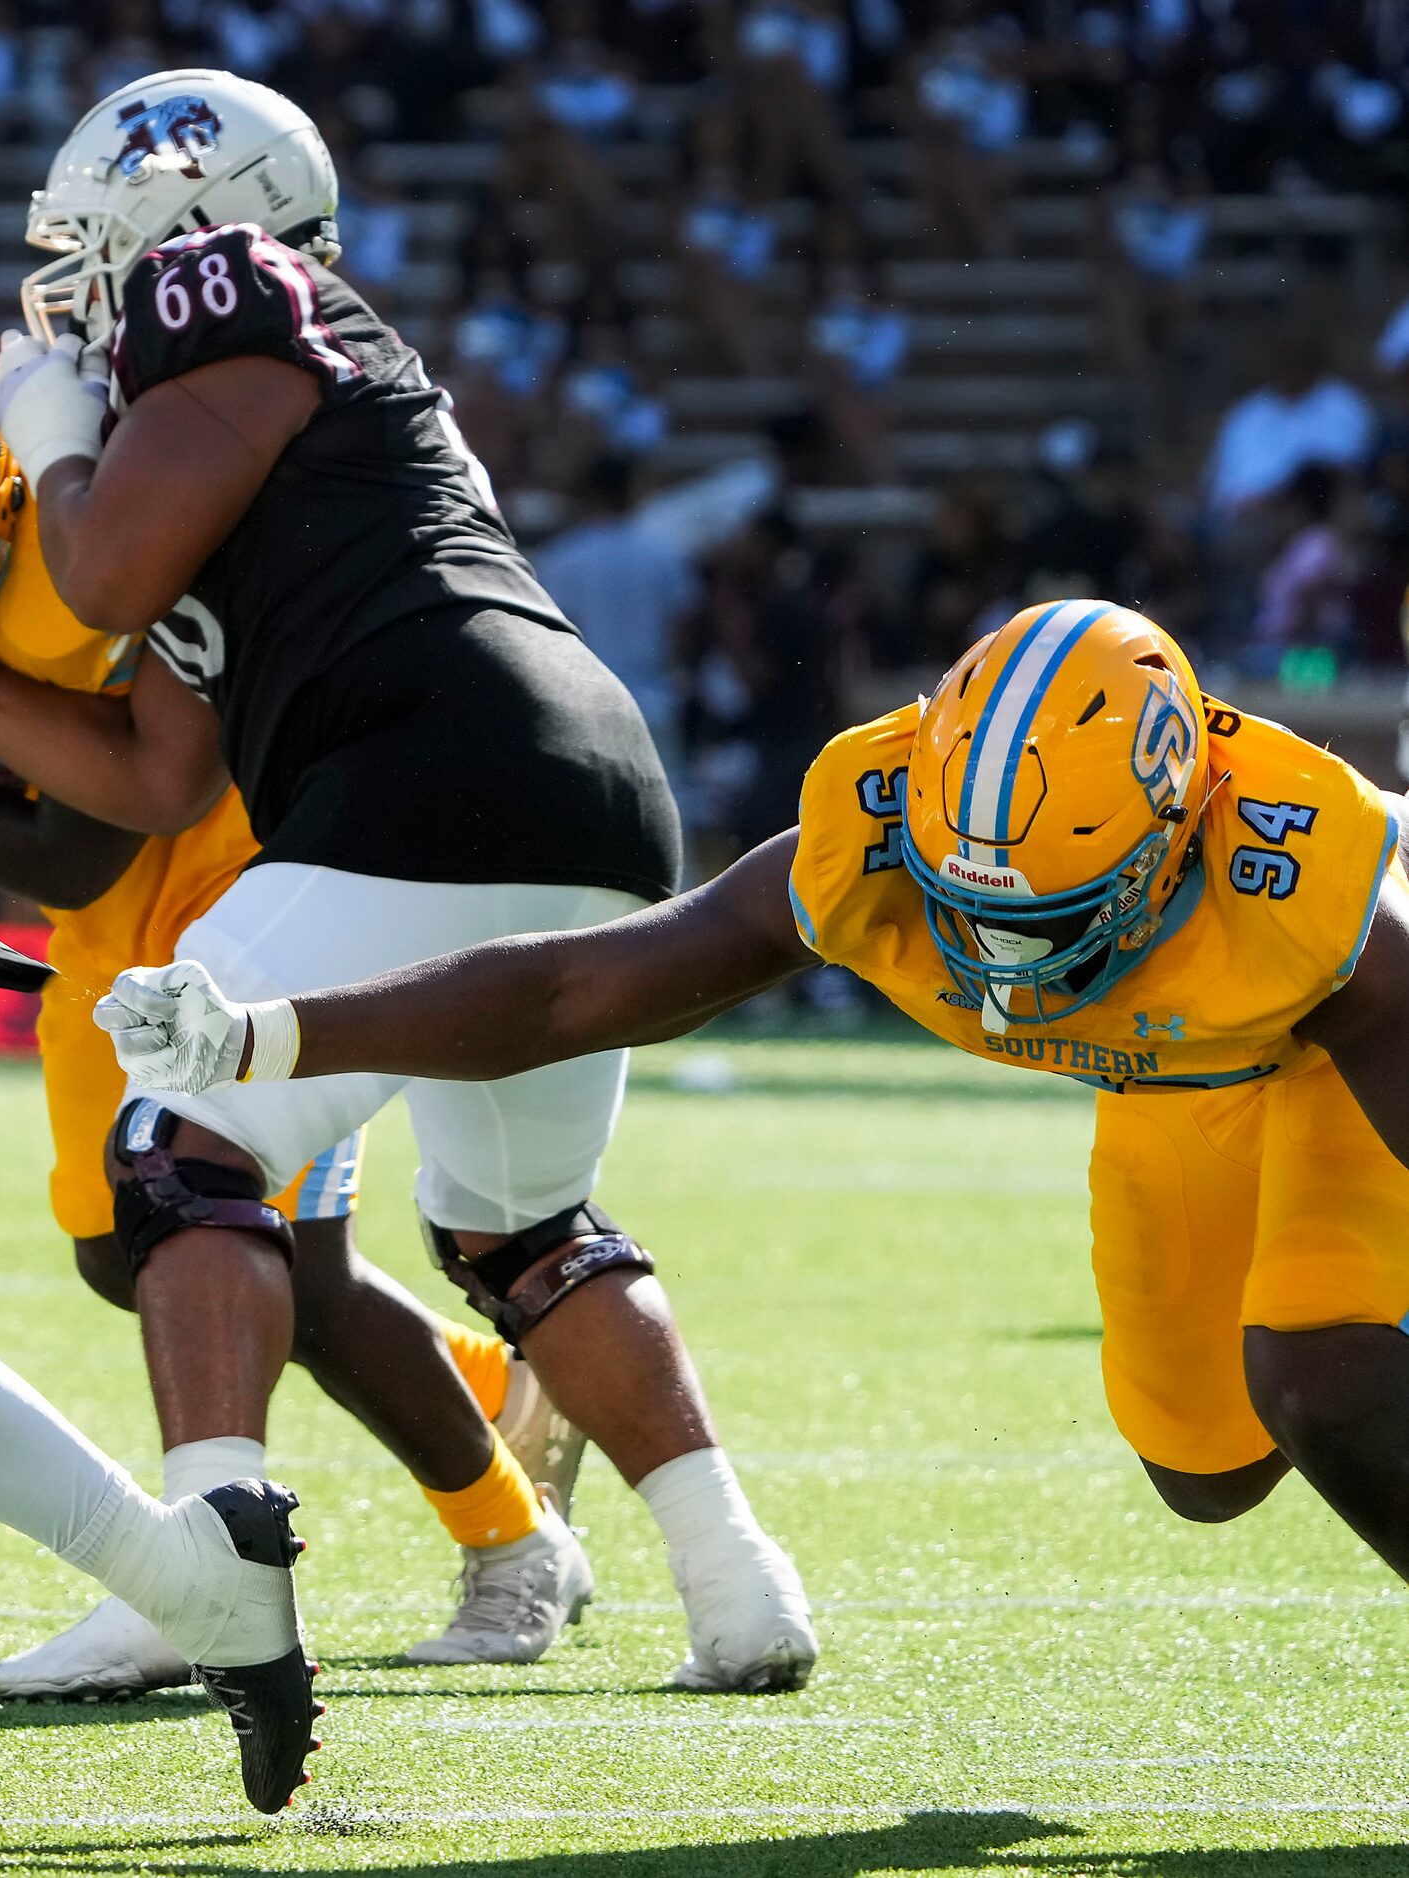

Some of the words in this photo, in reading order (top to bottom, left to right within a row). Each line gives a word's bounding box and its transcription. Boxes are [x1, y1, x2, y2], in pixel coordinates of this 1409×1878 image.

[155, 252, 238, 329] 68
[948, 861, 1015, 889] Riddell
[1229, 796, 1320, 901] 94
[983, 1035, 1159, 1074] SOUTHERN
